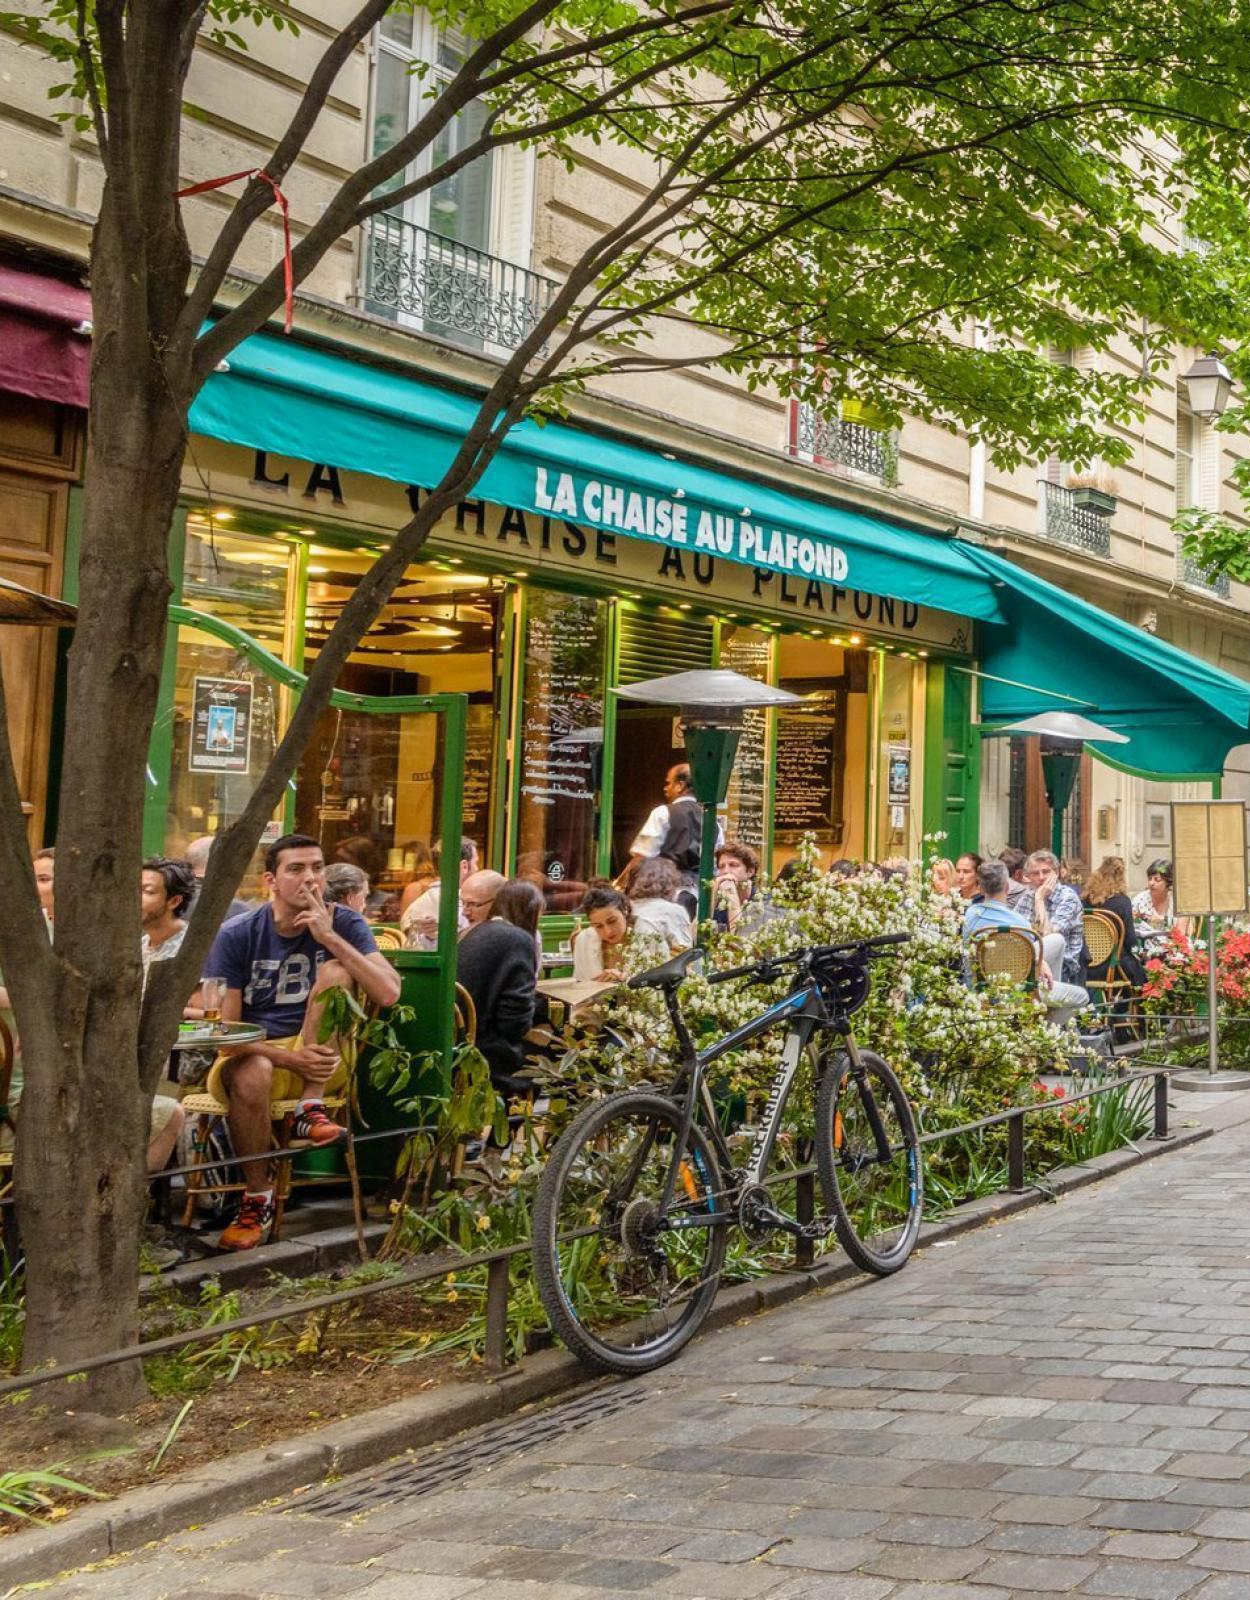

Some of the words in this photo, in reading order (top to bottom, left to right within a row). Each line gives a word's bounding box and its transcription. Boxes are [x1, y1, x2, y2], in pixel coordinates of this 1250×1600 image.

[254, 450, 345, 505] LA
[658, 546, 715, 584] AU
[752, 567, 919, 629] PLAFOND
[534, 466, 577, 517] LA
[583, 480, 687, 543] CHAISE
[695, 510, 734, 554] AU
[739, 521, 849, 582] PLAFOND
[747, 1061, 790, 1171] ROCKRIDER
